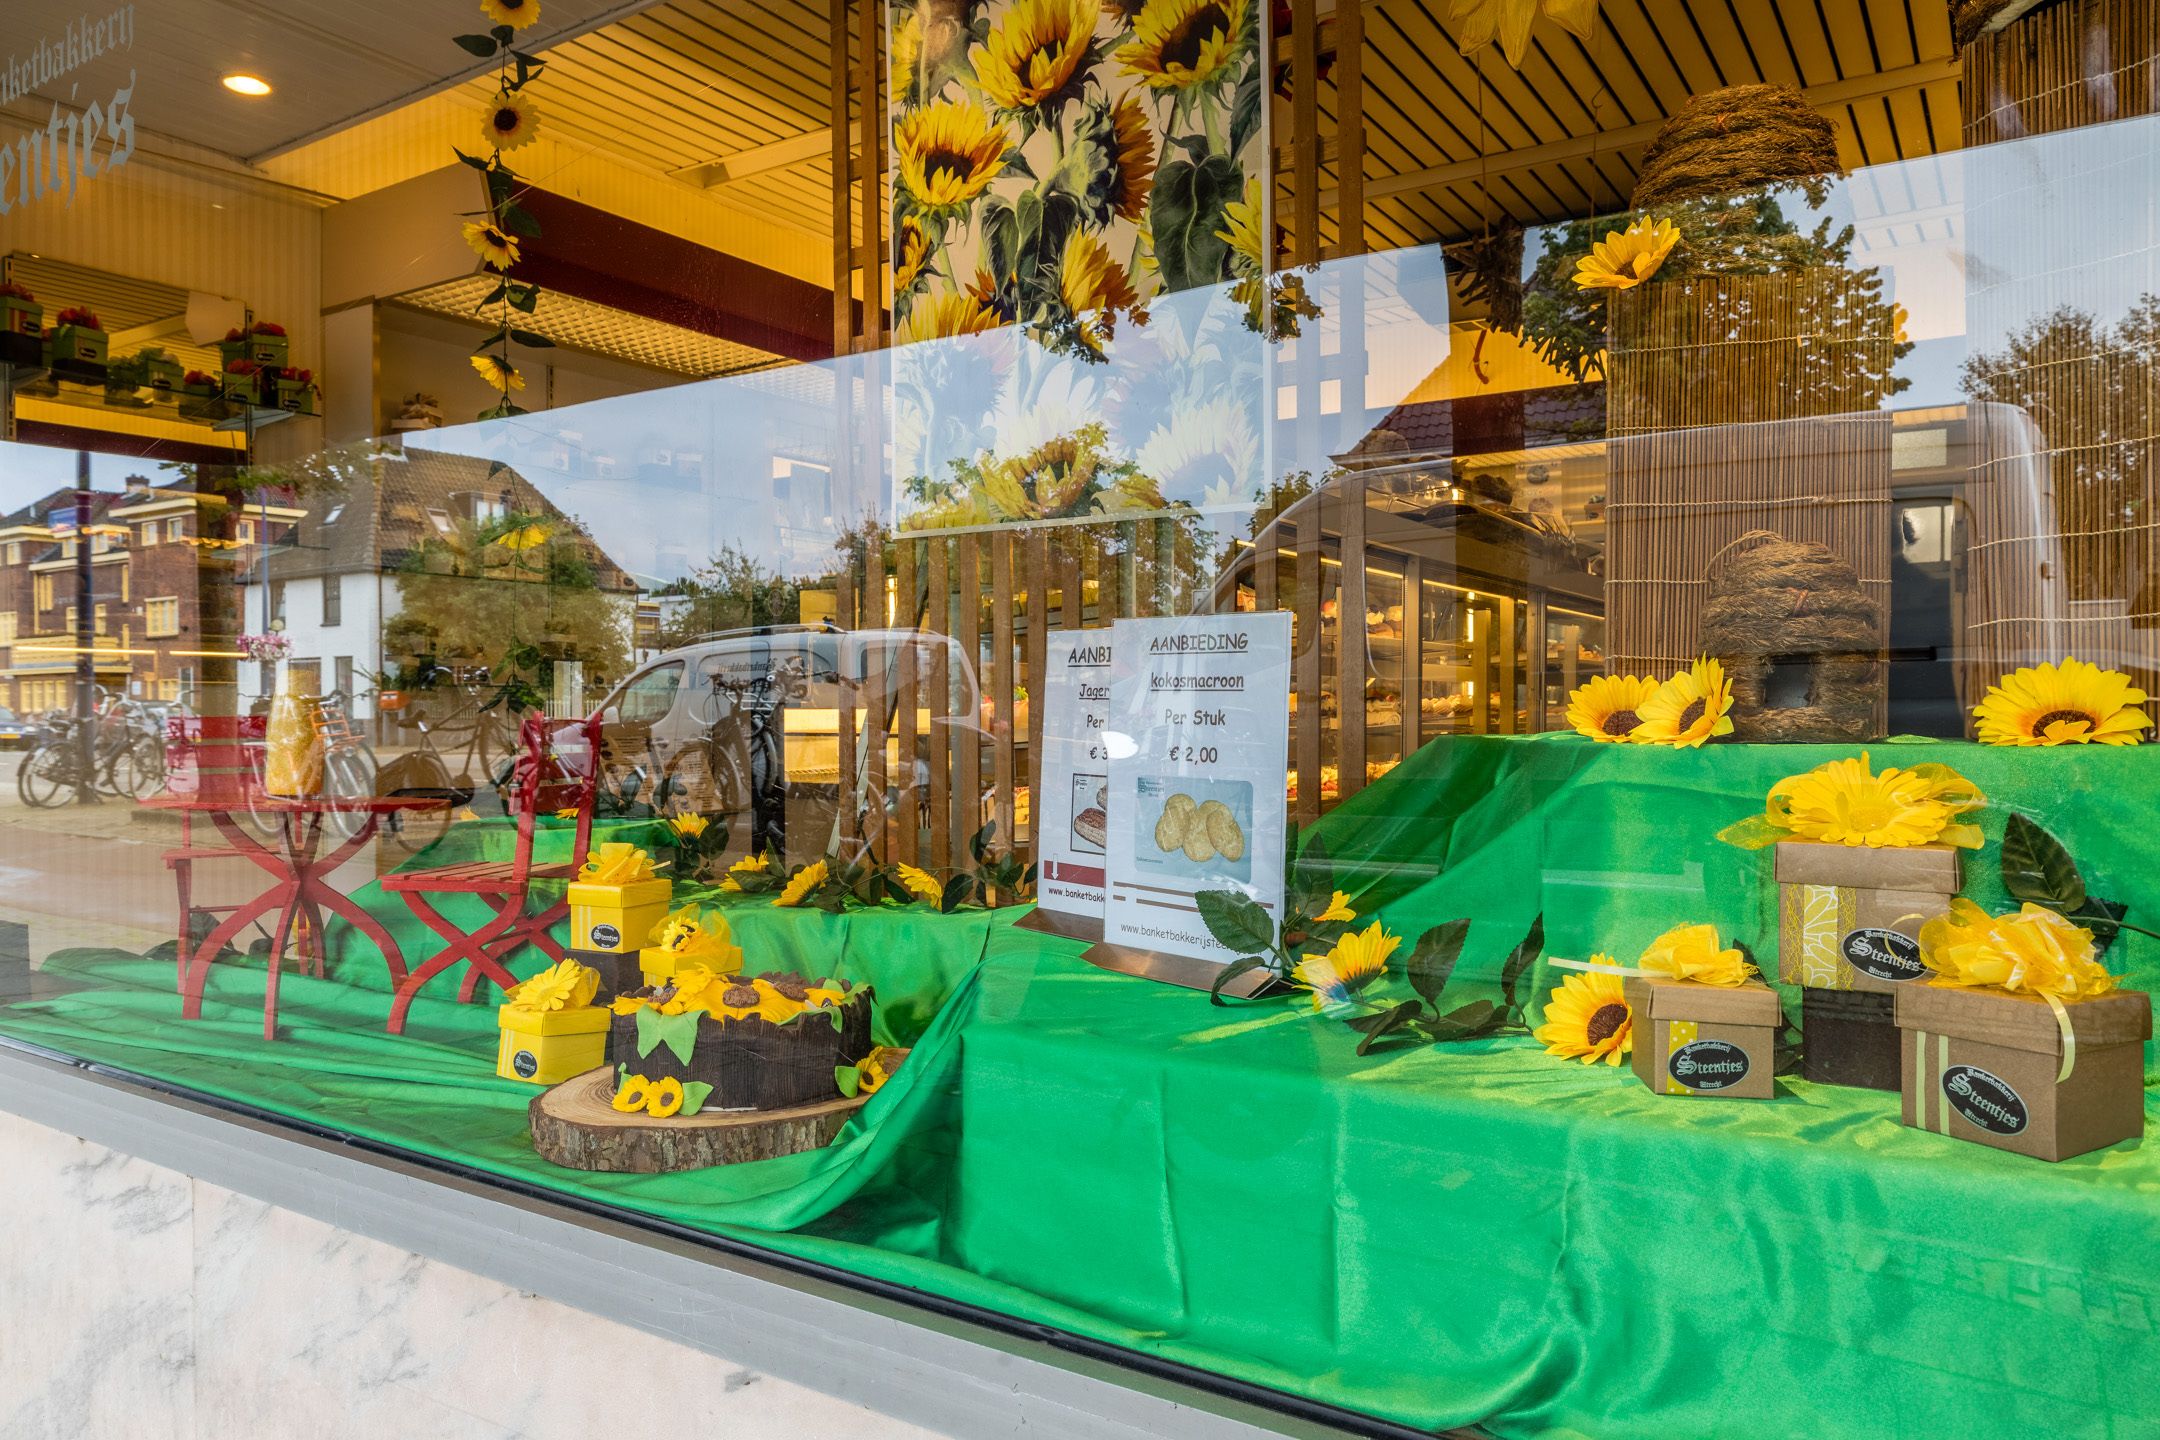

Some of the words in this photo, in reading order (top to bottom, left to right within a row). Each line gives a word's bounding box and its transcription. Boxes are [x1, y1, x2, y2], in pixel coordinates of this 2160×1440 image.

[1149, 632, 1249, 652] AANBIEDING
[1151, 671, 1245, 688] kokosmacroon
[1086, 714, 1105, 729] Per
[1165, 708, 1187, 725] Per
[1193, 708, 1226, 726] Stuk
[1089, 746, 1098, 760] €
[1169, 745, 1180, 762] €
[1185, 746, 1218, 766] 2,00
[1676, 1054, 1744, 1076] Steentjes
[1947, 1072, 2021, 1129] Steentjes
